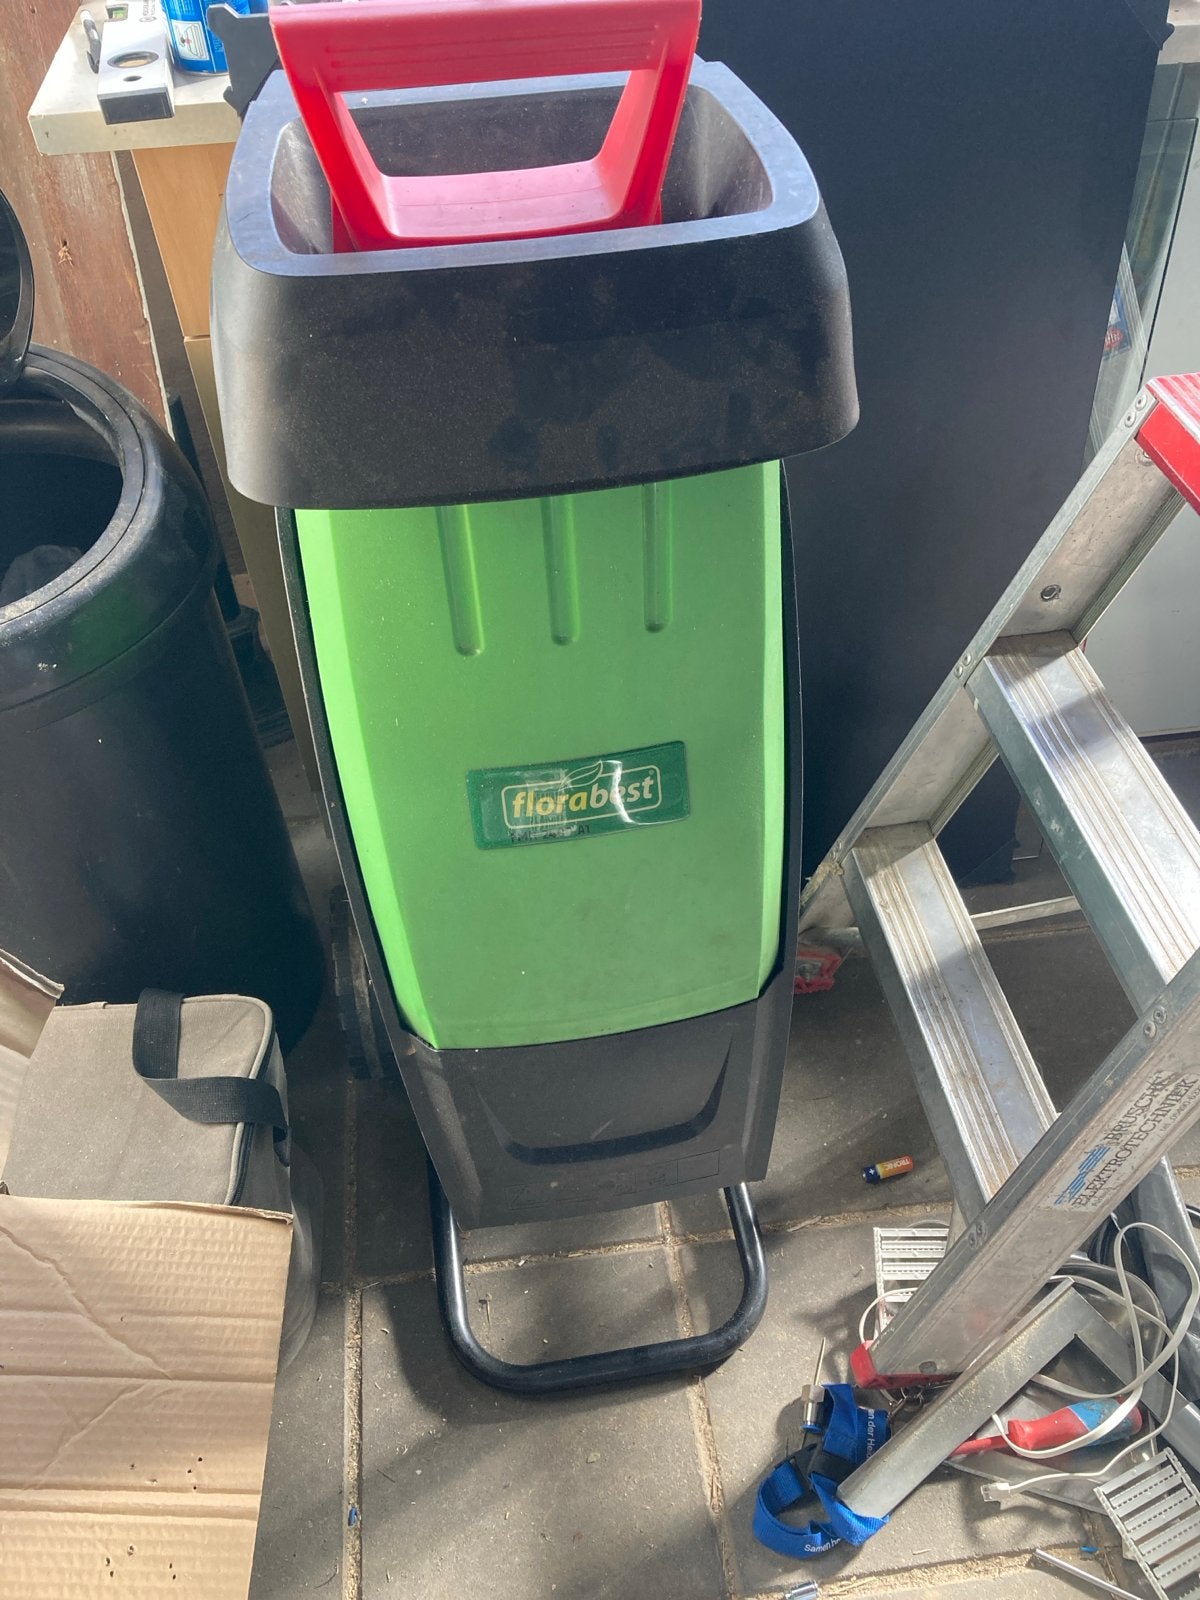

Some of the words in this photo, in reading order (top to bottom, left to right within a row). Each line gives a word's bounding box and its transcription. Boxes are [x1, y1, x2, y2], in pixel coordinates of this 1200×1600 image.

[512, 776, 654, 818] florabest
[1072, 1079, 1199, 1206] ELEKTROTECHNIEK
[868, 1421, 876, 1437] der
[804, 1542, 831, 1552] Samen
